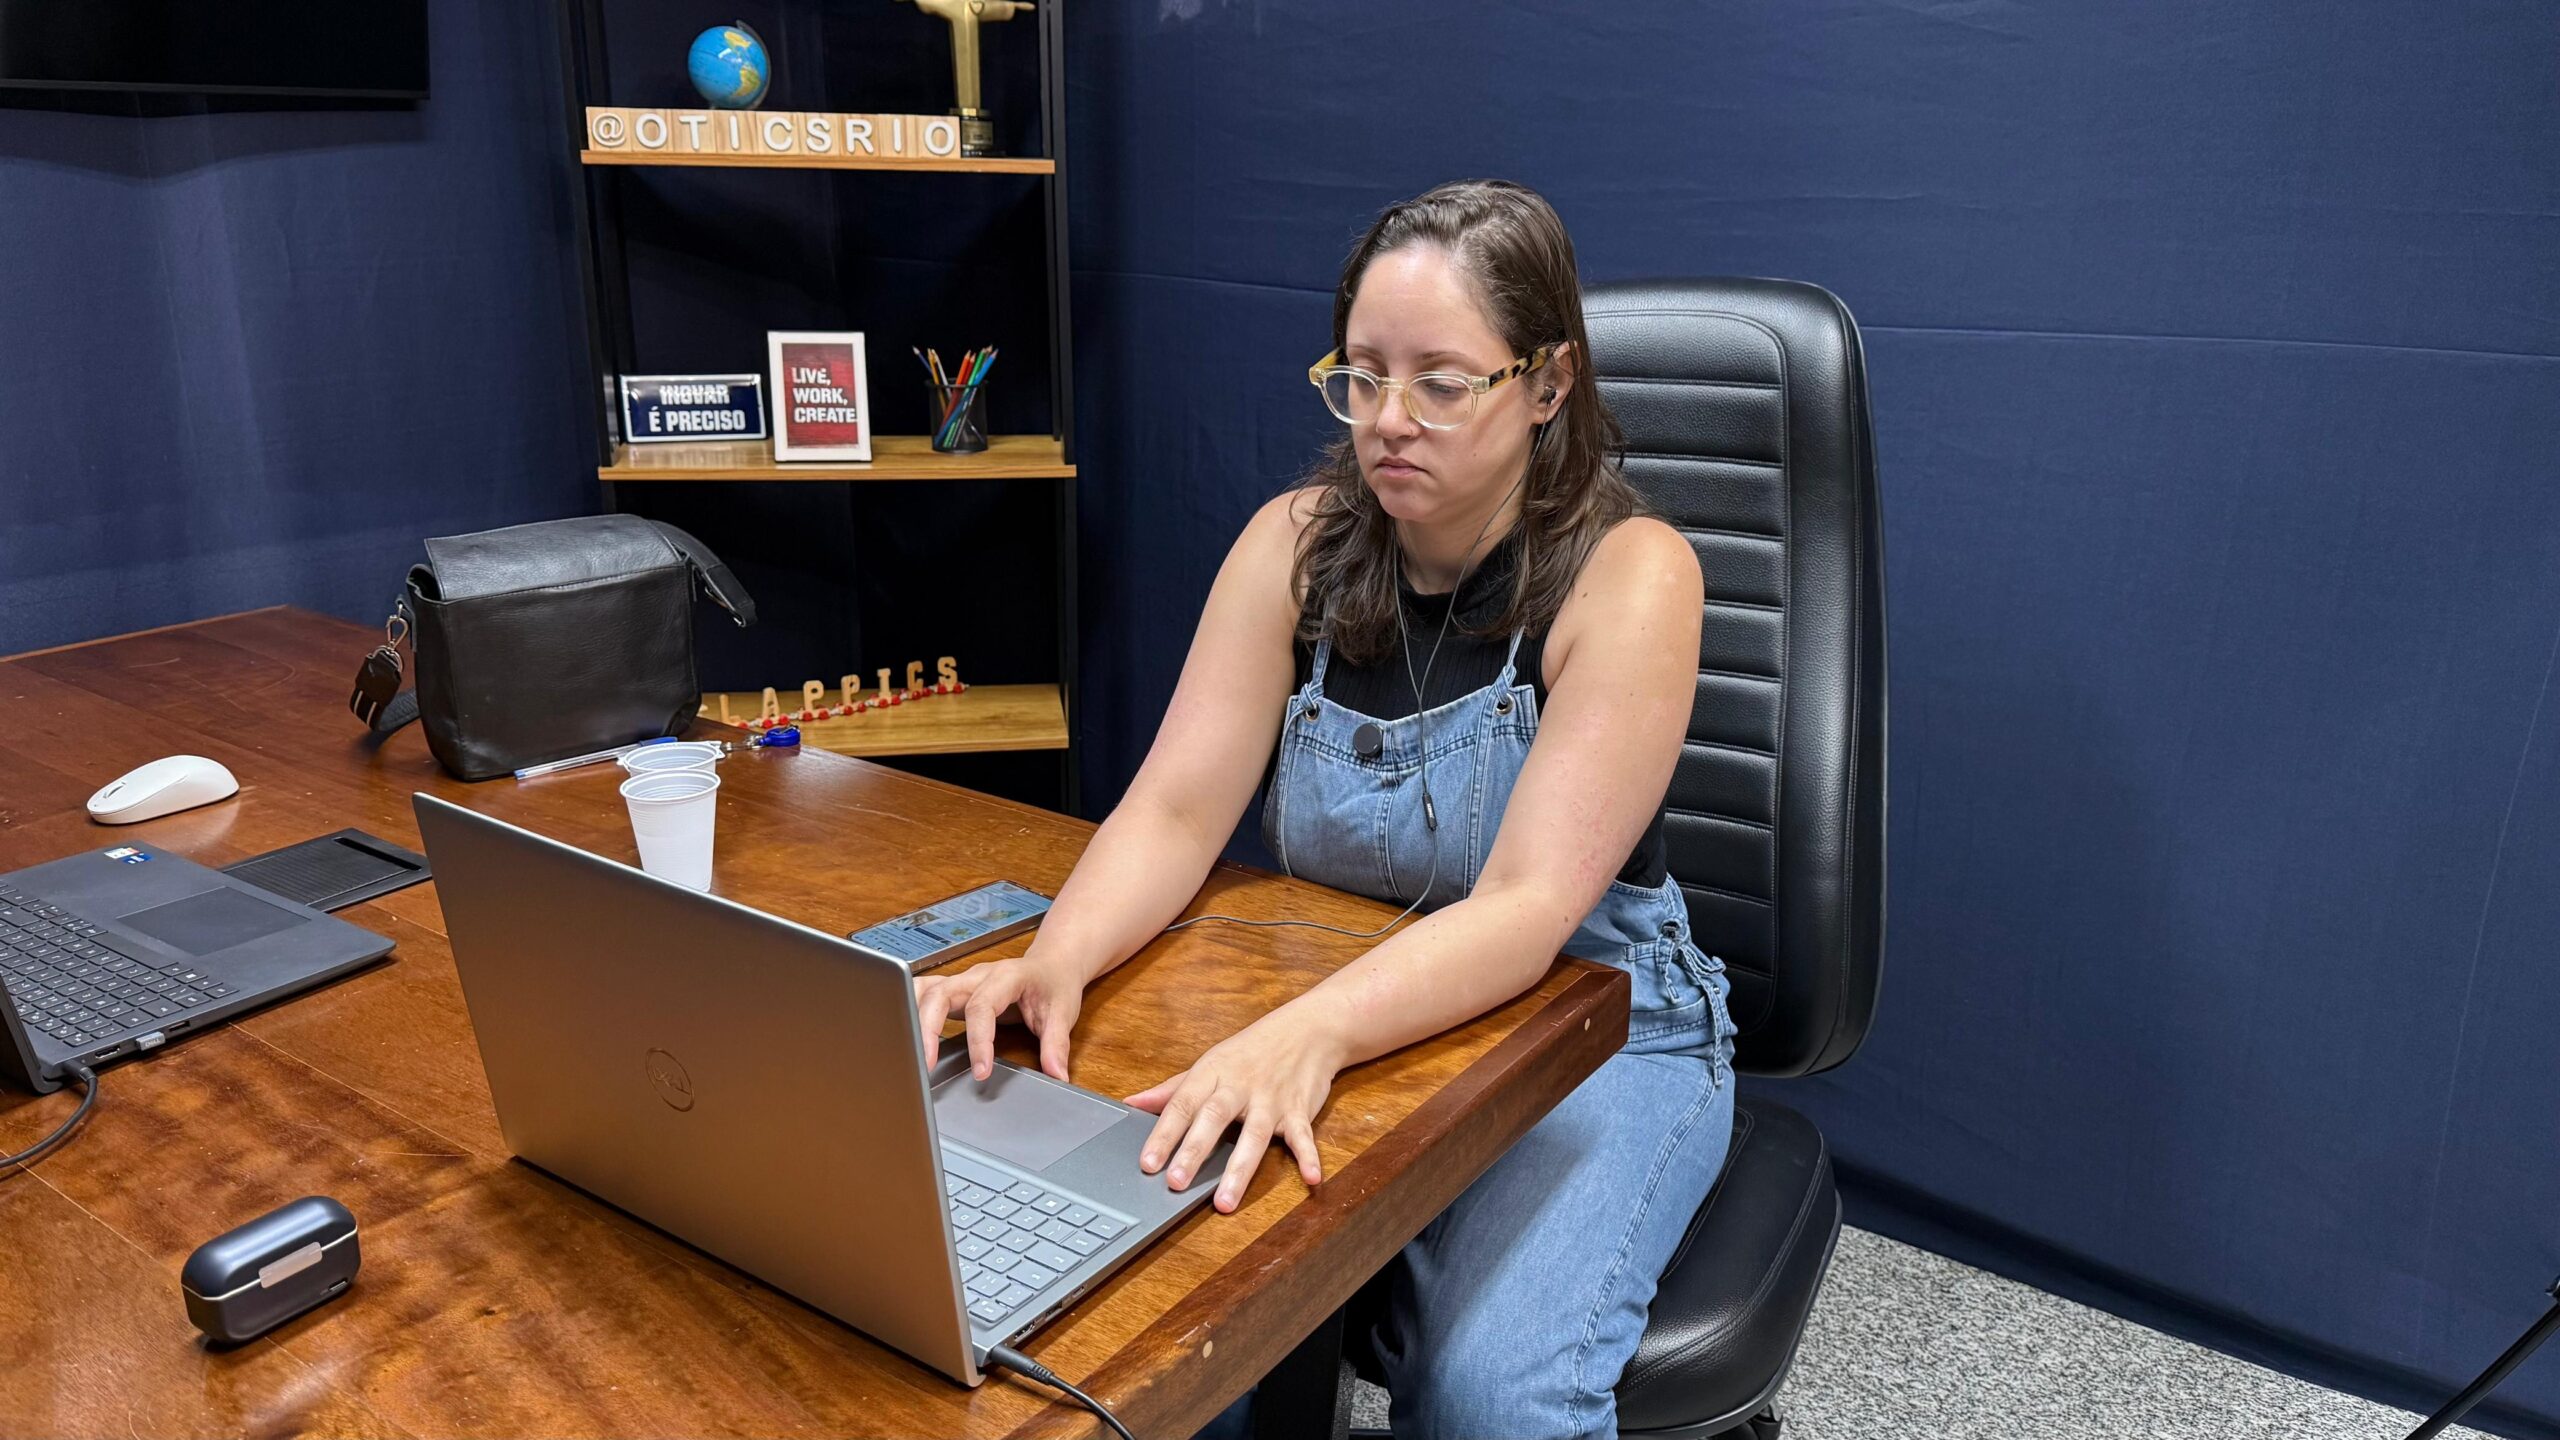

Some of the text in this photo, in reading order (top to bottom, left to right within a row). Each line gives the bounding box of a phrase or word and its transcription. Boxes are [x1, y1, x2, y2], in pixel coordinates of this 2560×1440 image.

[591, 113, 956, 156] @OTICSRIO
[791, 366, 831, 386] LIVE,
[659, 384, 730, 405] INOVAR
[792, 387, 848, 406] WORK,
[648, 405, 746, 432] É PRECISO
[719, 656, 959, 727] LAPPICS
